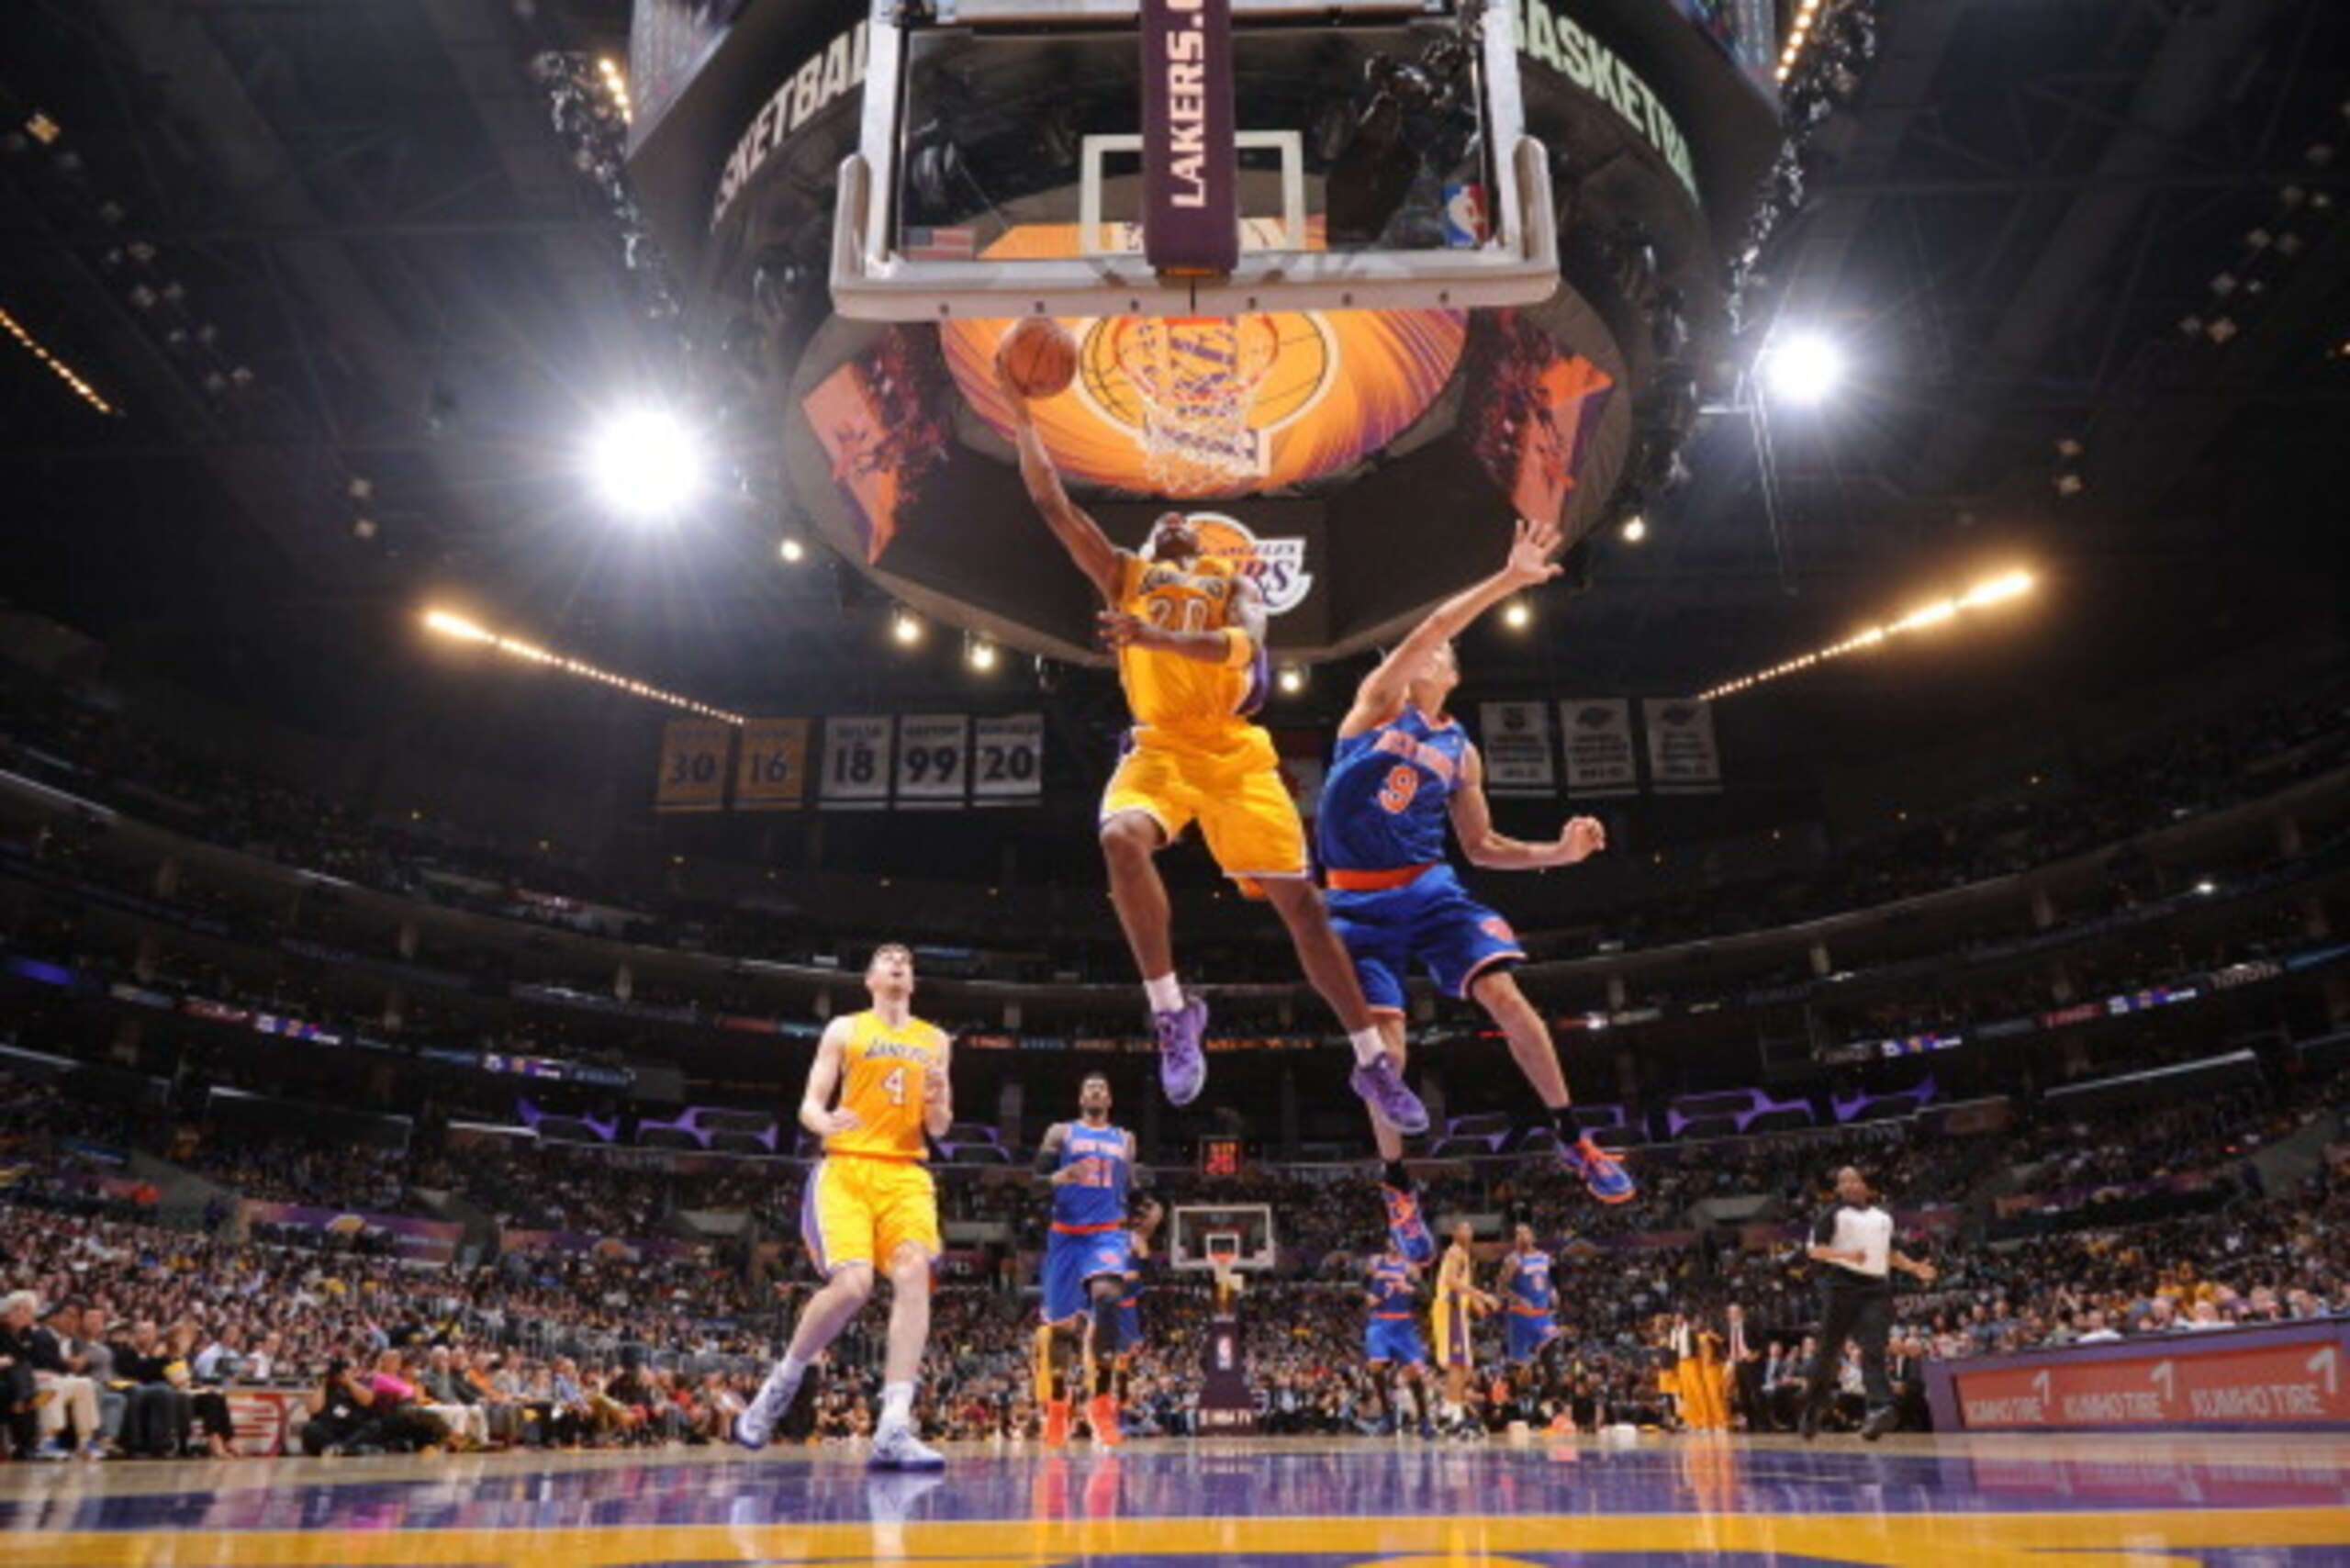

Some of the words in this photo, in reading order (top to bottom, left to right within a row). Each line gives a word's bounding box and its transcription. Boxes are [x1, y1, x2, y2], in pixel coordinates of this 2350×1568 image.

[752, 750, 787, 783] 16
[834, 747, 875, 784] 18
[905, 745, 957, 783] 99
[984, 745, 1033, 780] 20
[1379, 764, 1419, 814] 9
[882, 1065, 907, 1105] 4
